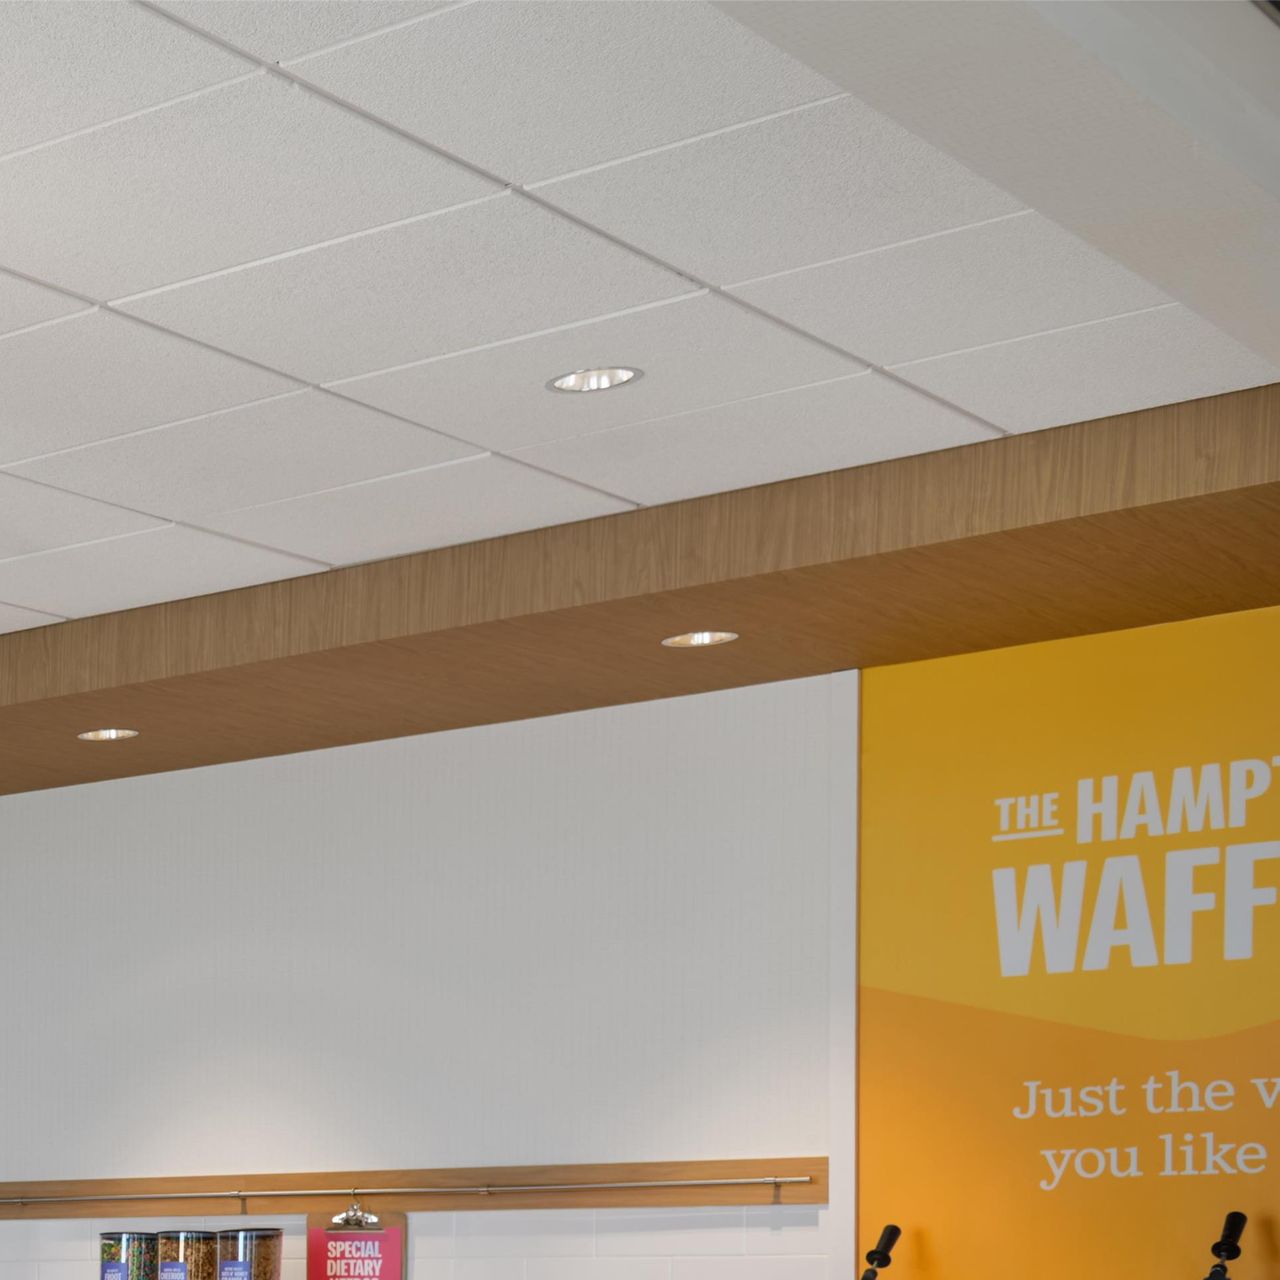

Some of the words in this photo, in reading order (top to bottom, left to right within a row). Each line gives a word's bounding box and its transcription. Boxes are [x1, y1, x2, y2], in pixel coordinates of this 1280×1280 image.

[994, 792, 1059, 832] THE
[1076, 755, 1280, 845] HAMP
[991, 840, 1280, 978] WAFF
[1012, 1076, 1127, 1120] Just
[1141, 1070, 1236, 1114] the
[1039, 1145, 1144, 1191] you
[1158, 1132, 1268, 1177] like
[326, 1259, 383, 1277] DIETARY
[327, 1240, 382, 1258] SPECIAL
